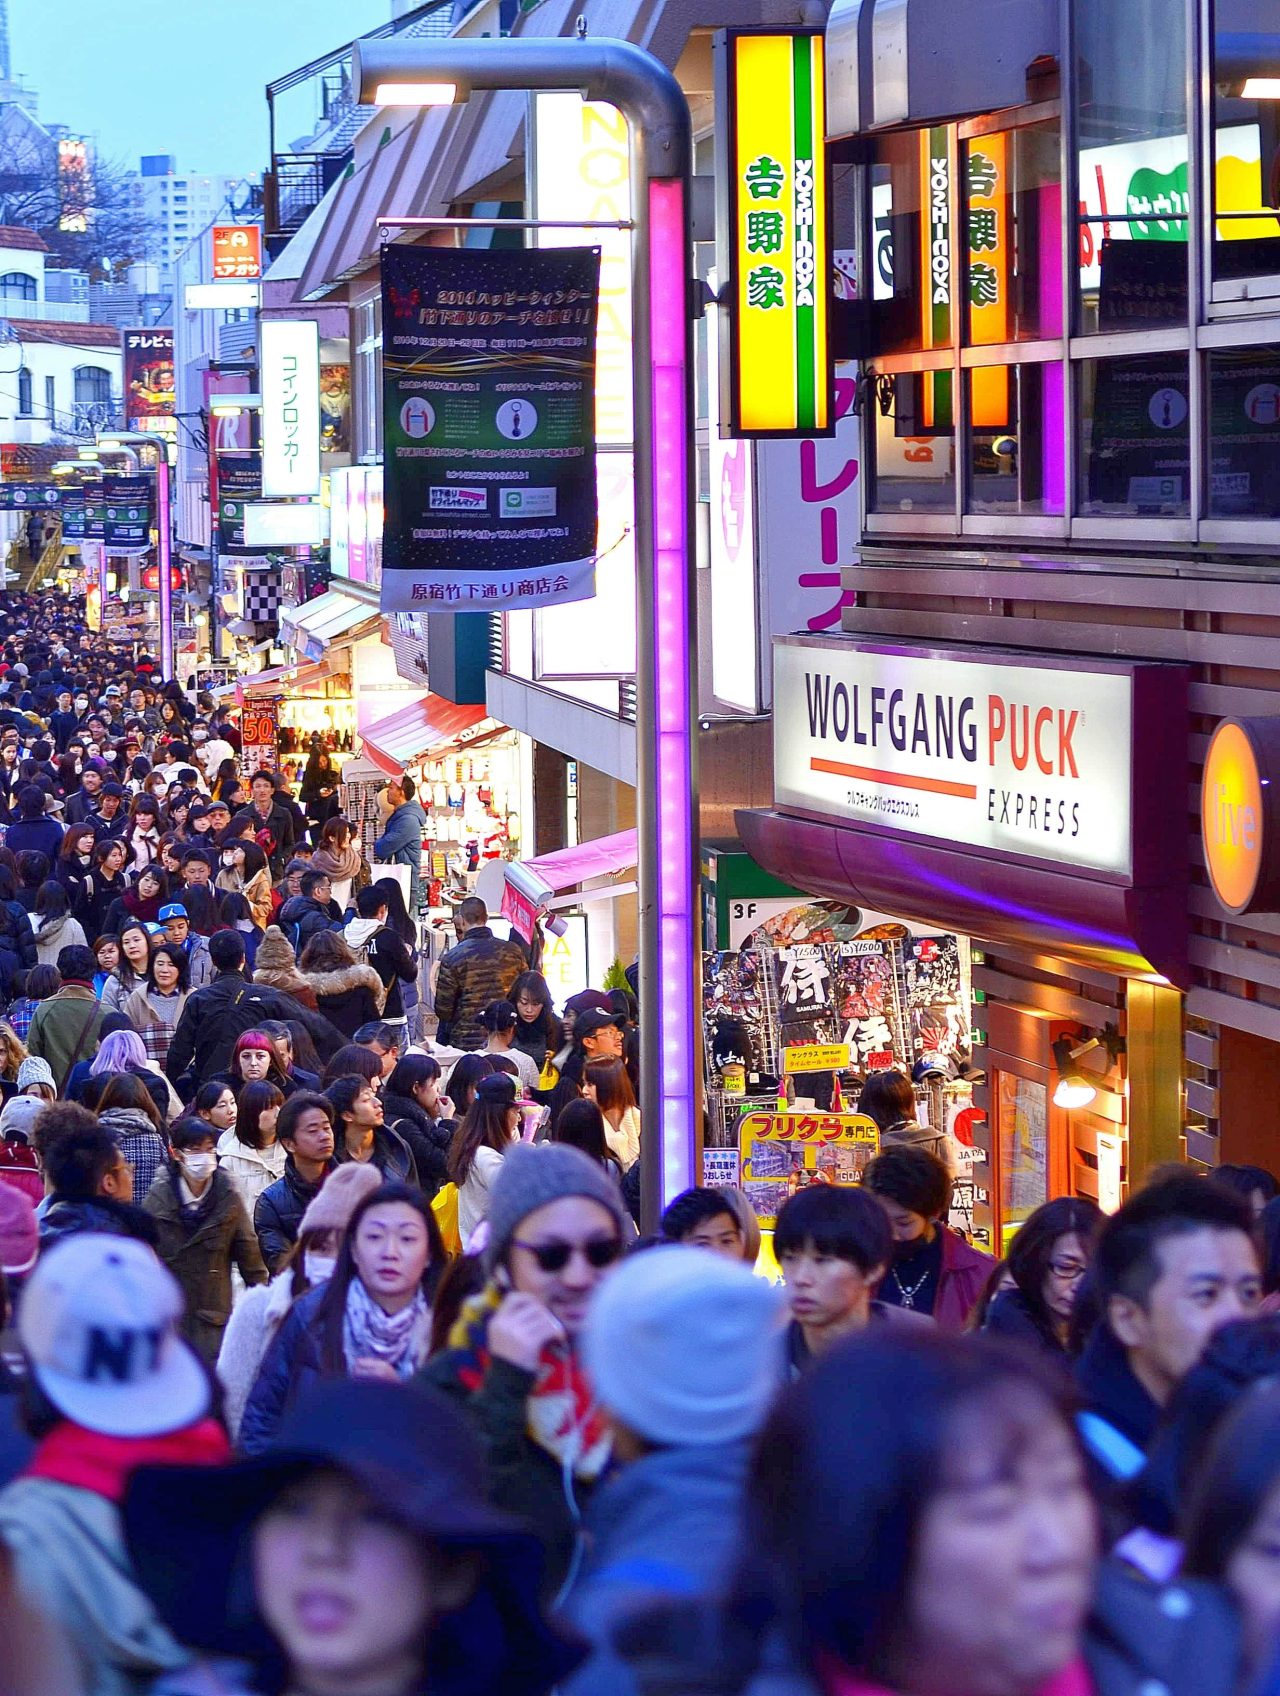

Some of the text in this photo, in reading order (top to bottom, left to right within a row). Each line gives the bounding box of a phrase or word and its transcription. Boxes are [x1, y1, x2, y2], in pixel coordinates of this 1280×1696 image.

[746, 156, 785, 309] 吉野家
[282, 356, 300, 473] コインロッカー
[411, 575, 569, 600] 原宿竹下通り商店会
[805, 672, 978, 763] WOLFGANG
[988, 694, 1081, 778] PUCK
[987, 788, 1080, 837] EXPRESS
[1213, 783, 1257, 850] live
[734, 903, 757, 920] 3F
[751, 1116, 844, 1140] プリクラ
[840, 1169, 863, 1181] GOA
